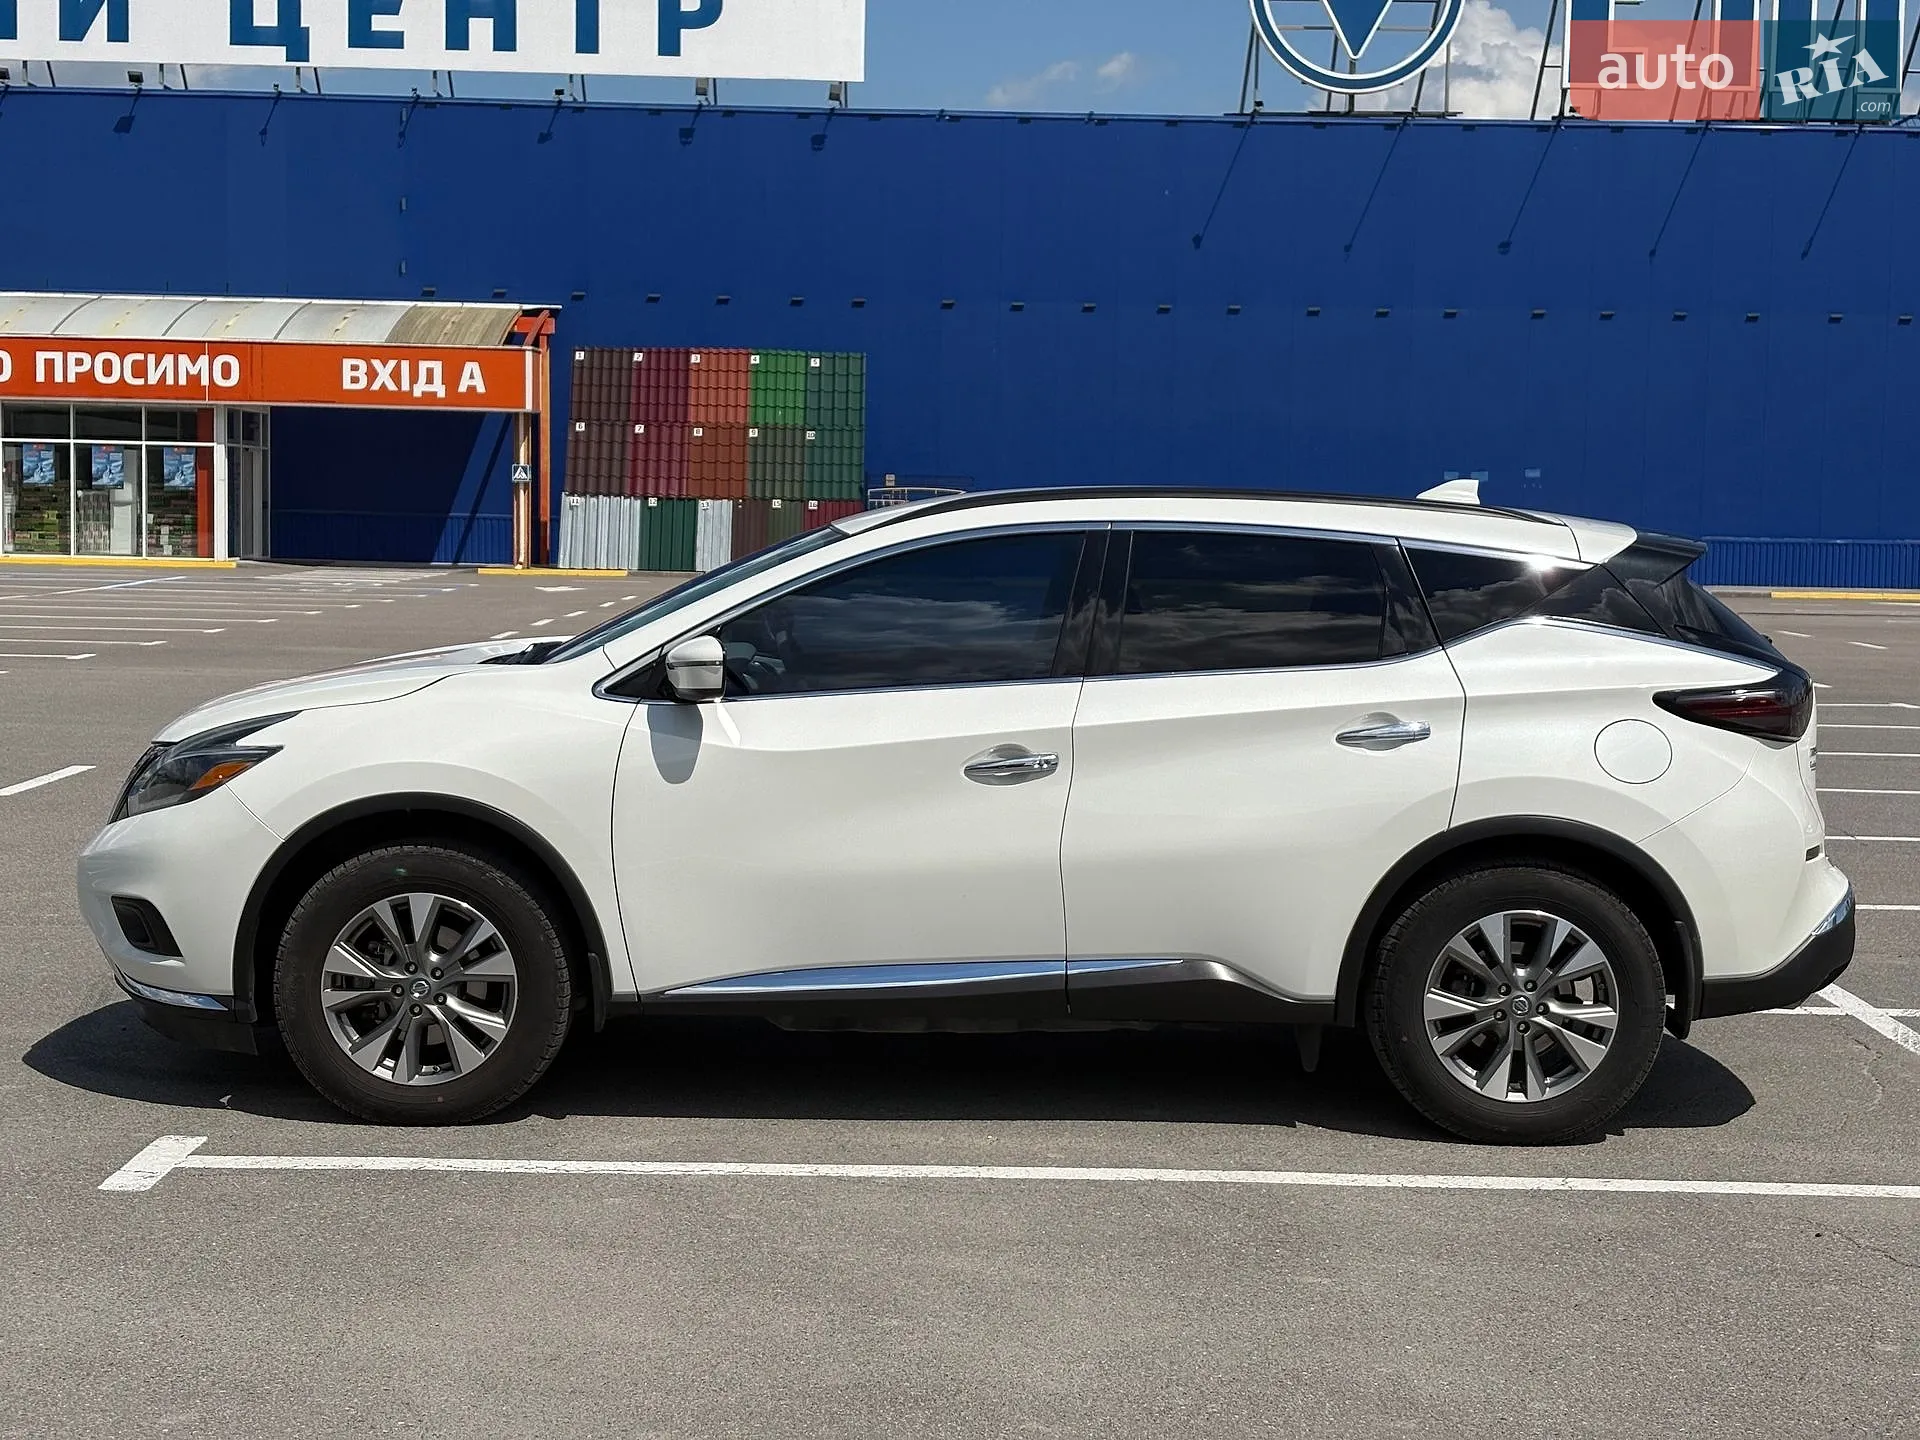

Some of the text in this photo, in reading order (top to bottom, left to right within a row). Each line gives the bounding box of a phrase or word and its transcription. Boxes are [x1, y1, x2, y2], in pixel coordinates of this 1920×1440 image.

[35, 351, 240, 388] ПРОСИМО
[342, 358, 487, 398] ВХІД А
